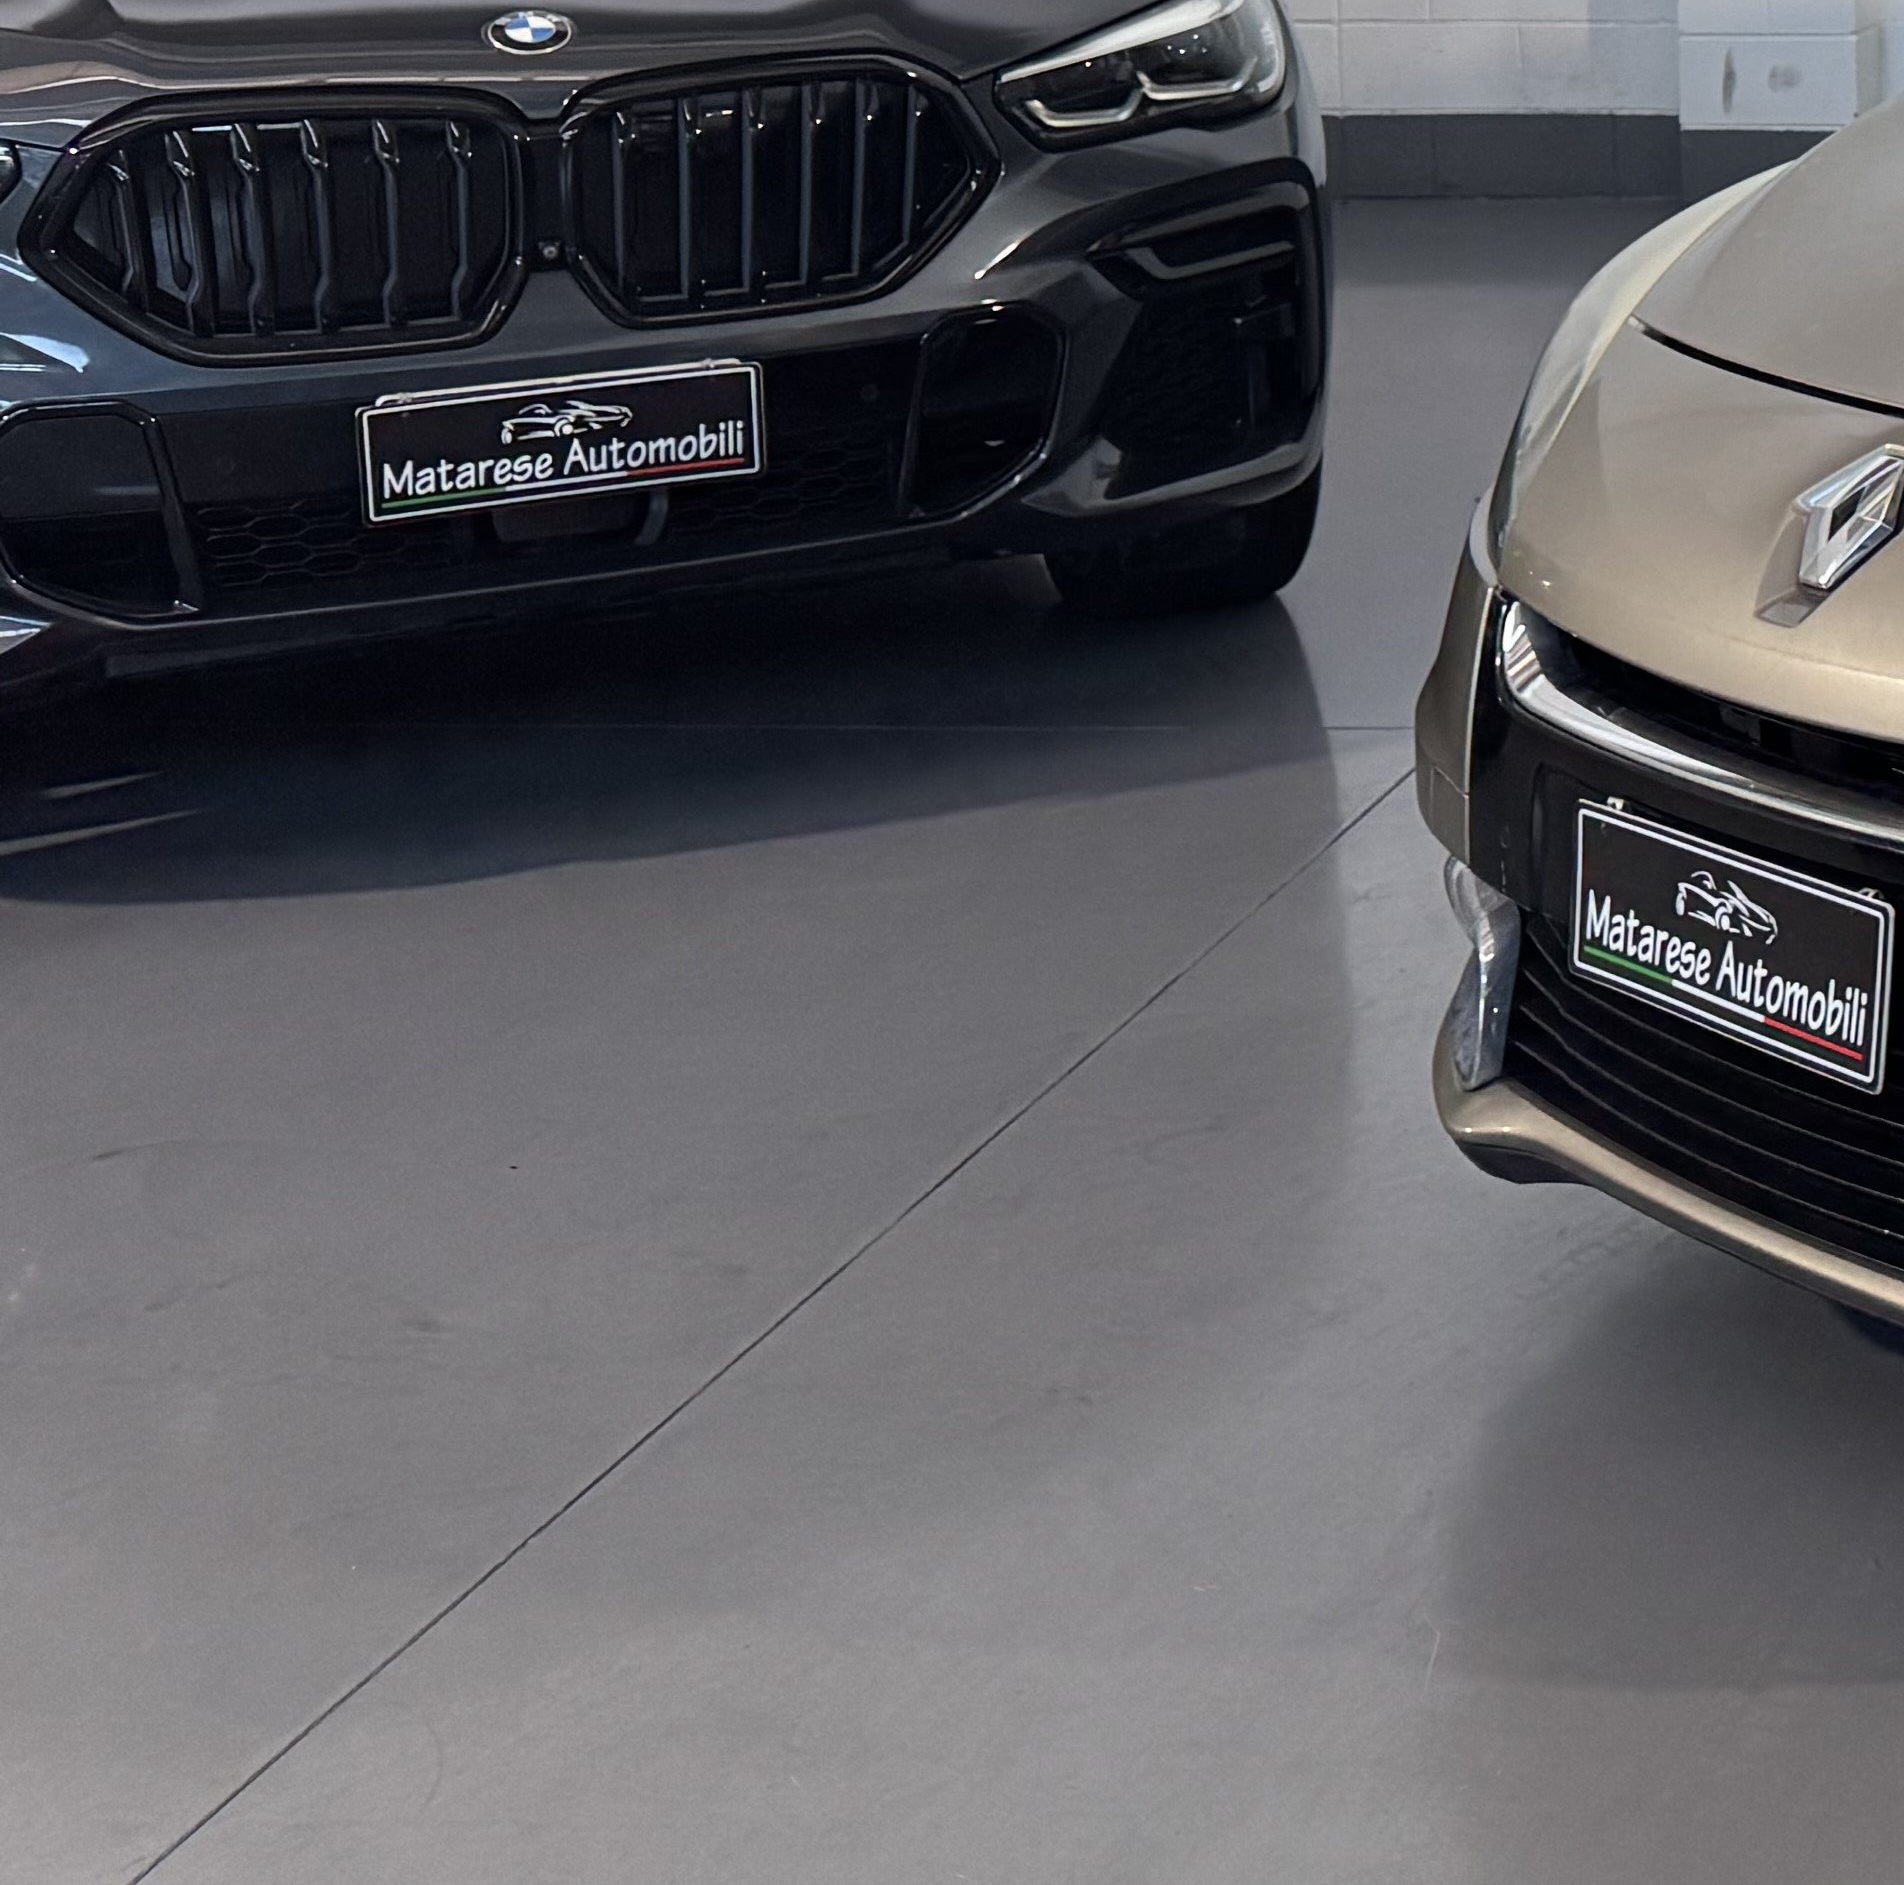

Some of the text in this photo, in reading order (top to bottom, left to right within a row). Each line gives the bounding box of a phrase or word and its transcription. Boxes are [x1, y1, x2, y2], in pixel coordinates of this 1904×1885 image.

[384, 421, 744, 499] Matarese Automobili
[1586, 889, 1868, 1047] Matarese Automobili
